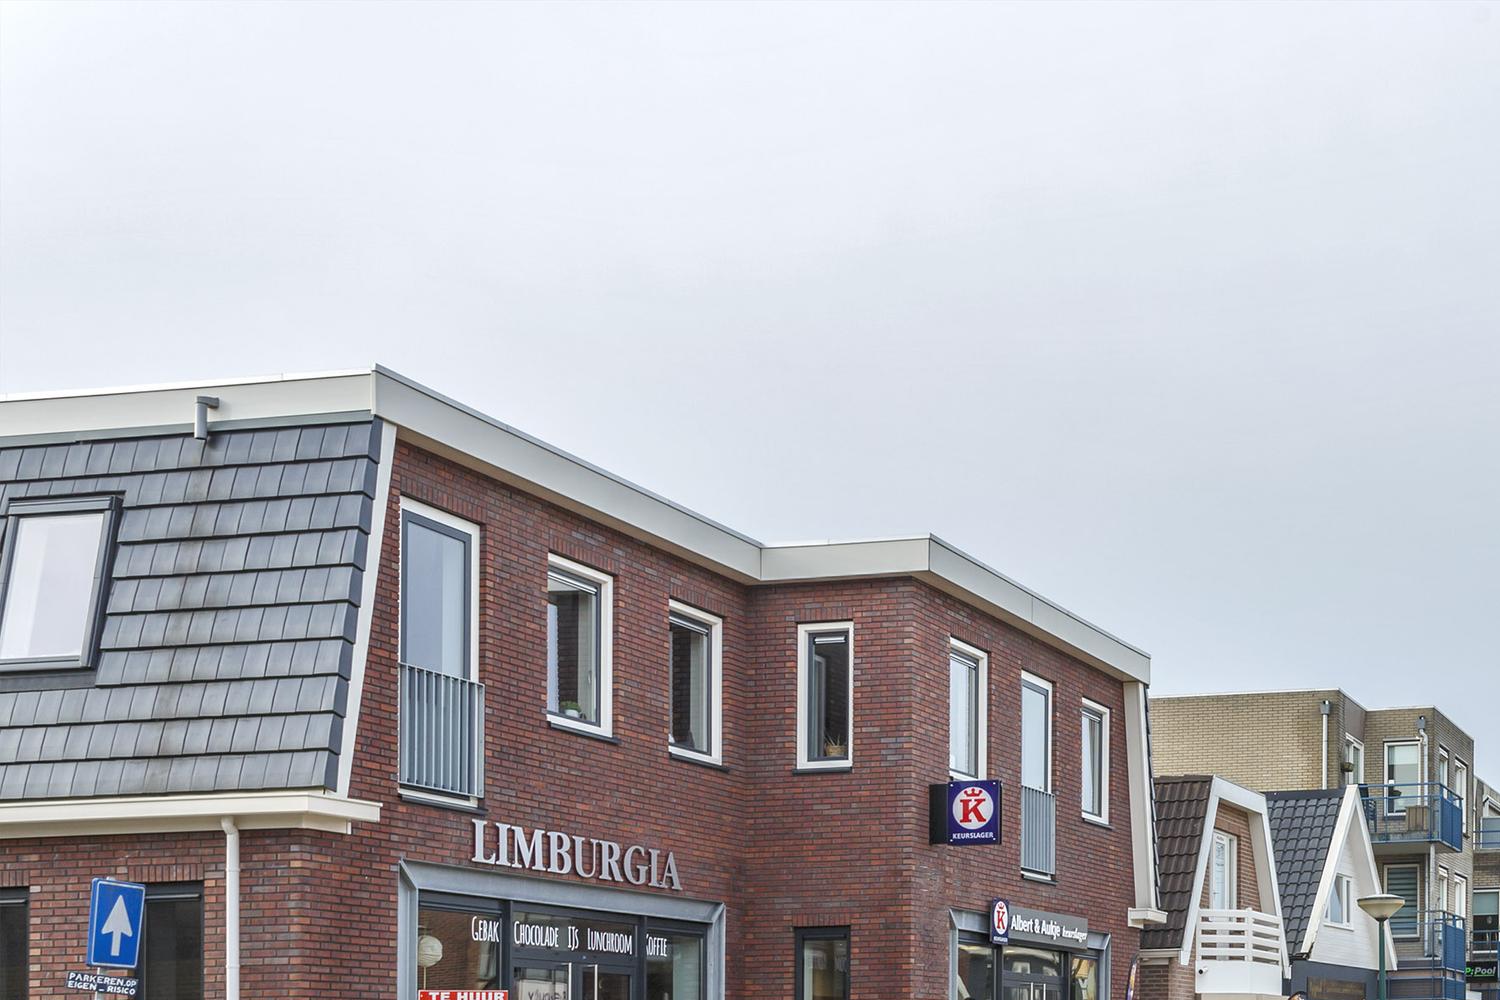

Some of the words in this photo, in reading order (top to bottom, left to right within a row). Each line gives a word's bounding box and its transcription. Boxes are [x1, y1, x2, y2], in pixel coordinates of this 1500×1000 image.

[959, 798, 987, 823] K
[952, 831, 994, 839] KEURSLAGER
[471, 818, 683, 891] LIMBURGIA
[471, 916, 499, 942] GEBAK
[513, 920, 559, 948] CHOCOLADE
[587, 927, 633, 955] LUNCHROOM
[1010, 914, 1033, 933] Albert
[1035, 919, 1041, 932] &
[1041, 919, 1061, 940] Aukje
[1465, 966, 1497, 975] P:Pool
[67, 980, 97, 991] EIGEN
[106, 985, 136, 995] RISICO
